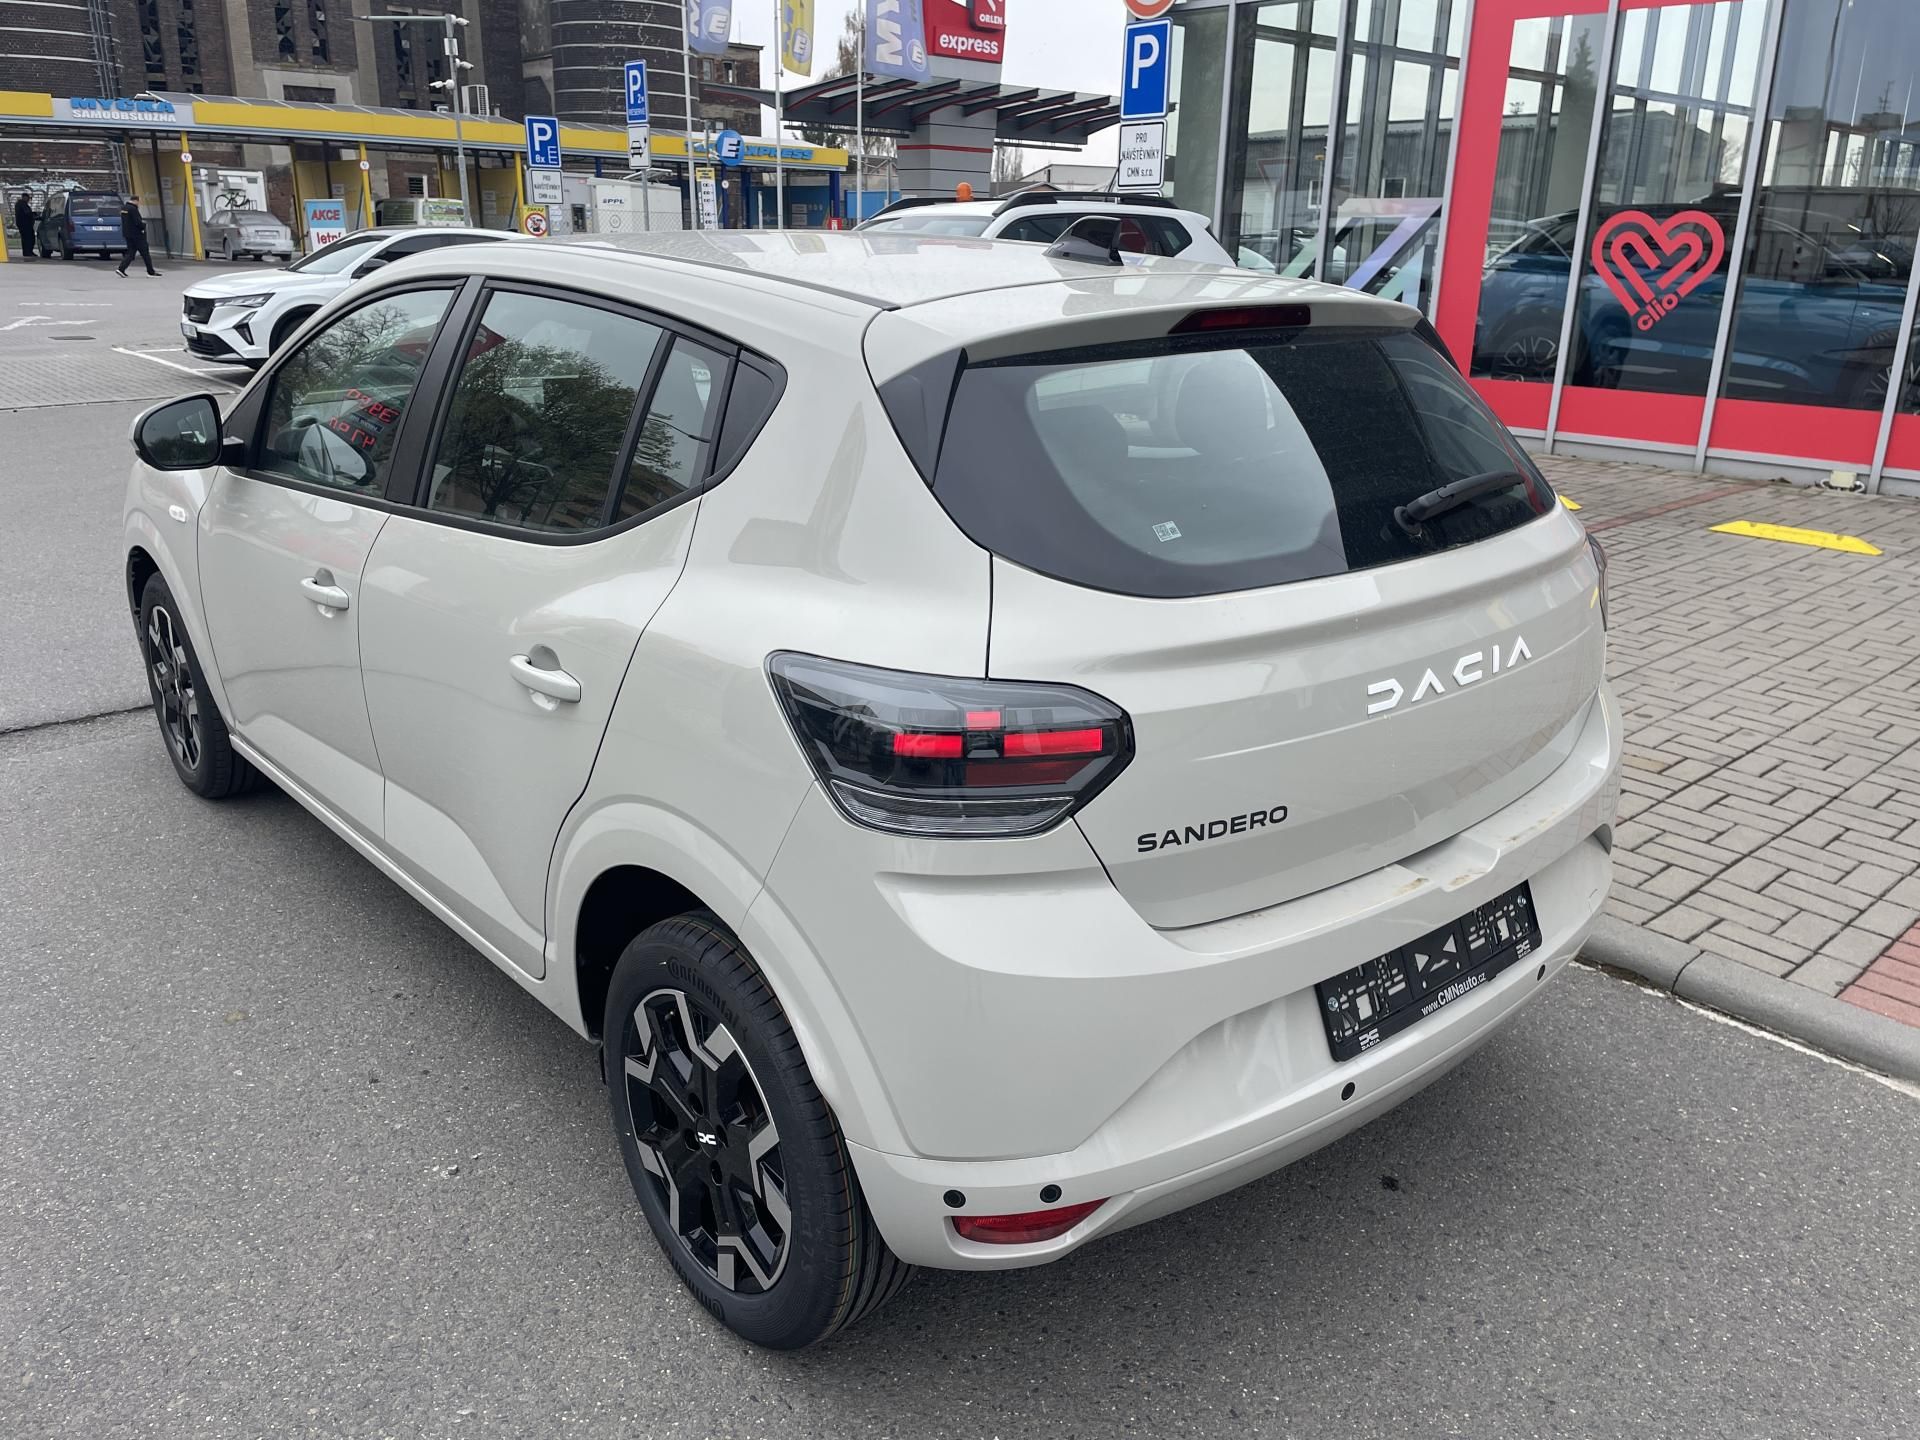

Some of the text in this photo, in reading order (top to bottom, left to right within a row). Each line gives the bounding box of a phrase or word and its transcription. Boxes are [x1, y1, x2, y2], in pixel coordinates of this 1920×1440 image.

[979, 13, 1003, 25] ORLEN
[940, 34, 999, 54] express
[1132, 34, 1160, 89] P
[629, 70, 641, 104] P
[533, 123, 552, 151] P
[1136, 133, 1148, 143] PRO
[1127, 167, 1140, 177] CMN
[312, 209, 341, 220] AKCE
[1637, 293, 1679, 331] clio
[1366, 634, 1532, 716] DACIA
[1137, 805, 1288, 853] SANDERO
[1421, 972, 1488, 1016] www.CMNauto.cz
